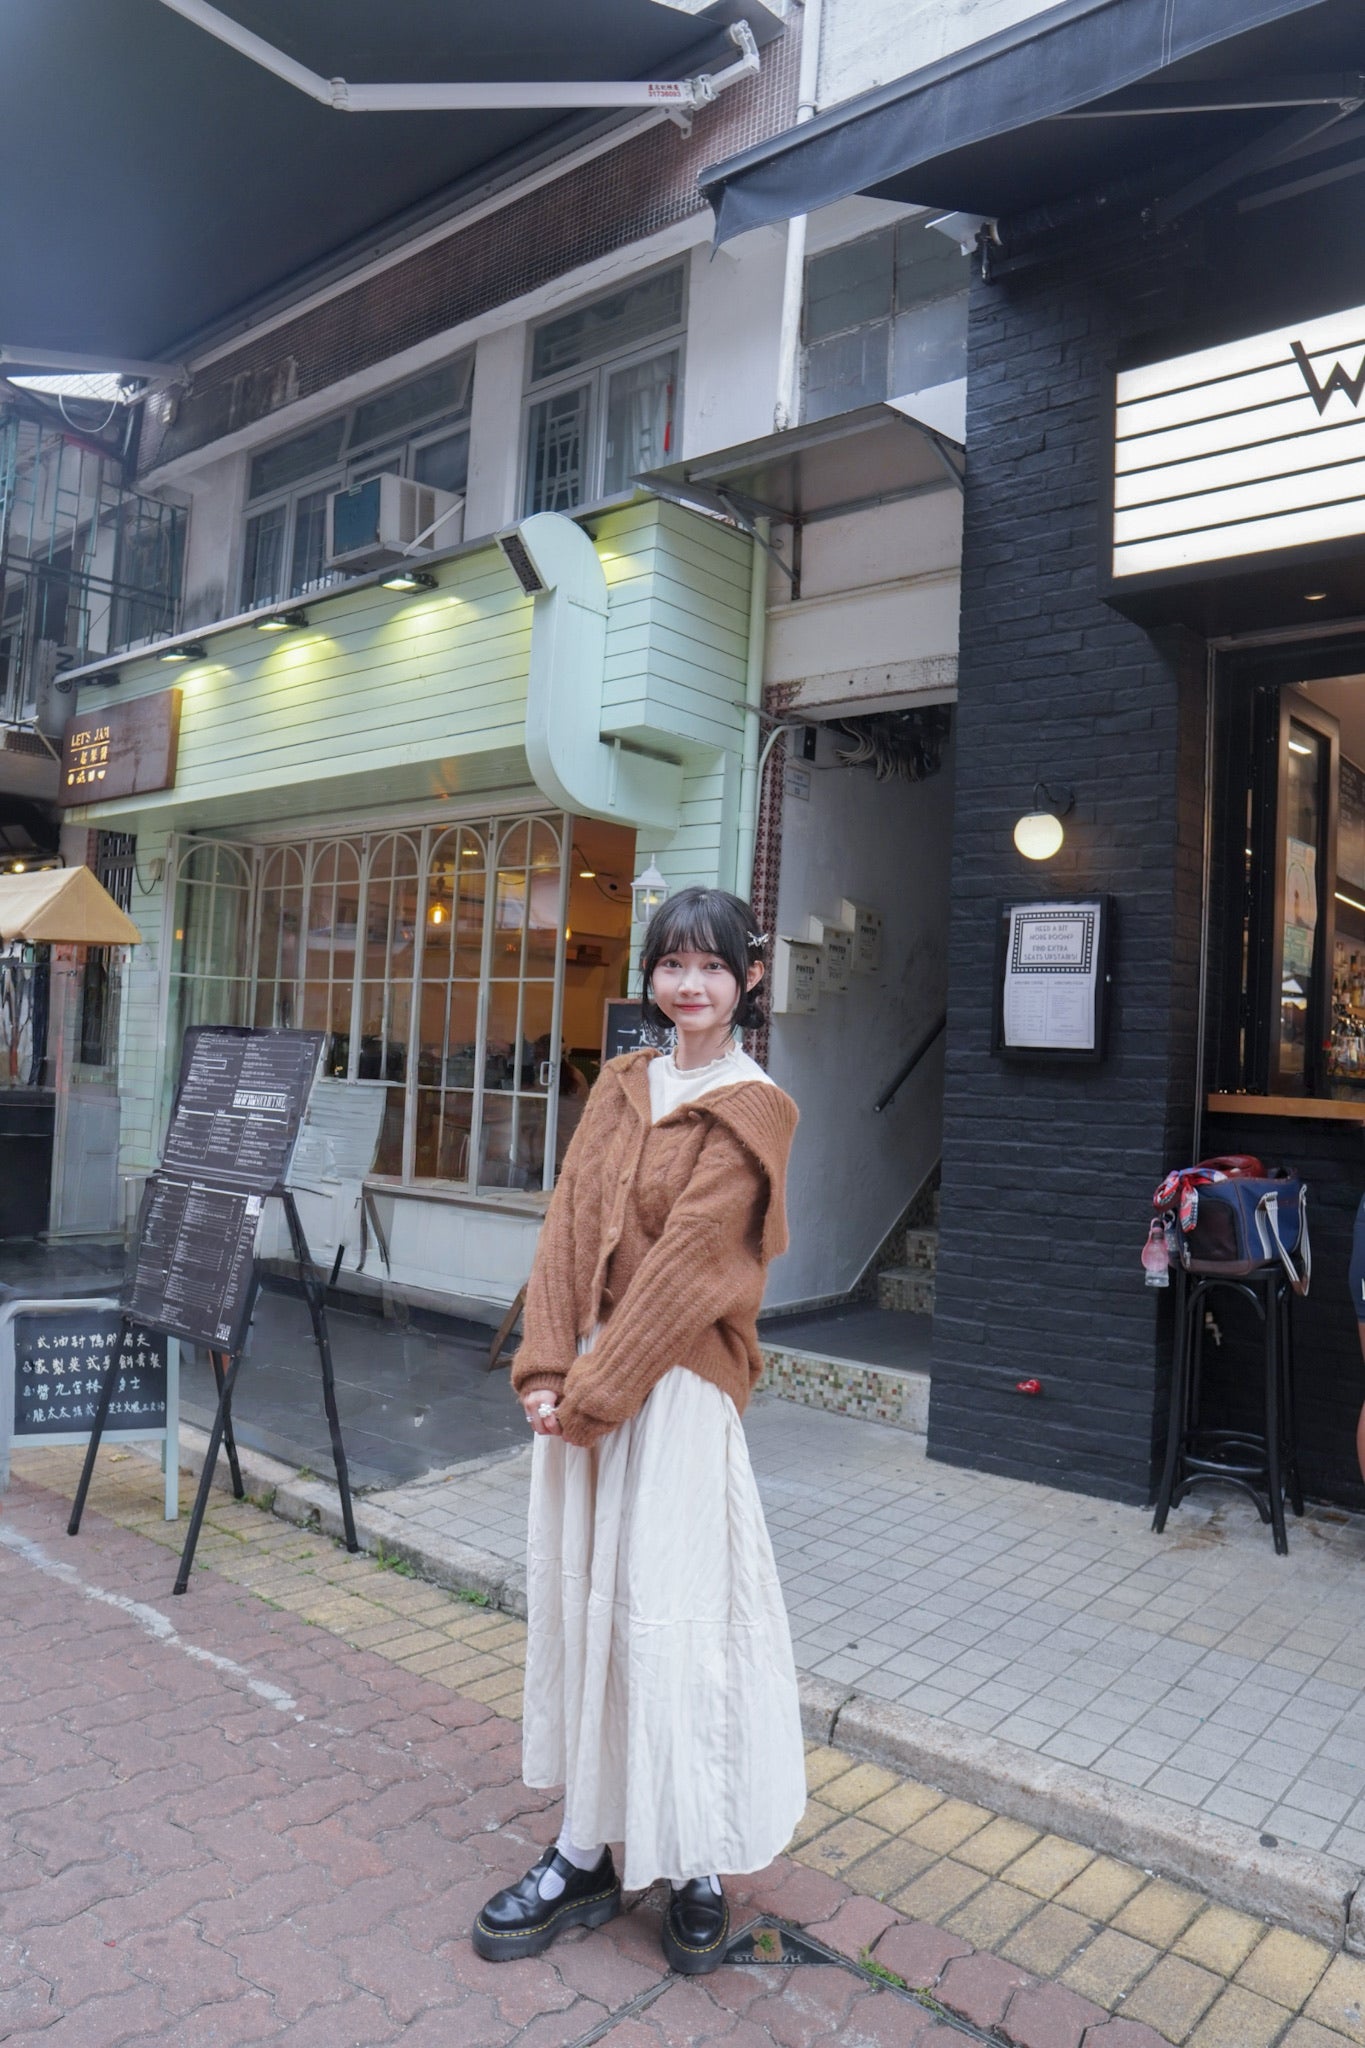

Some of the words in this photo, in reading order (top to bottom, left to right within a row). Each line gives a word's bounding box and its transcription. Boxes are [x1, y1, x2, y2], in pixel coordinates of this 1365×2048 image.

[71, 731, 91, 747] LET'S
[94, 726, 110, 741] JAM
[1024, 953, 1043, 961] SEATS
